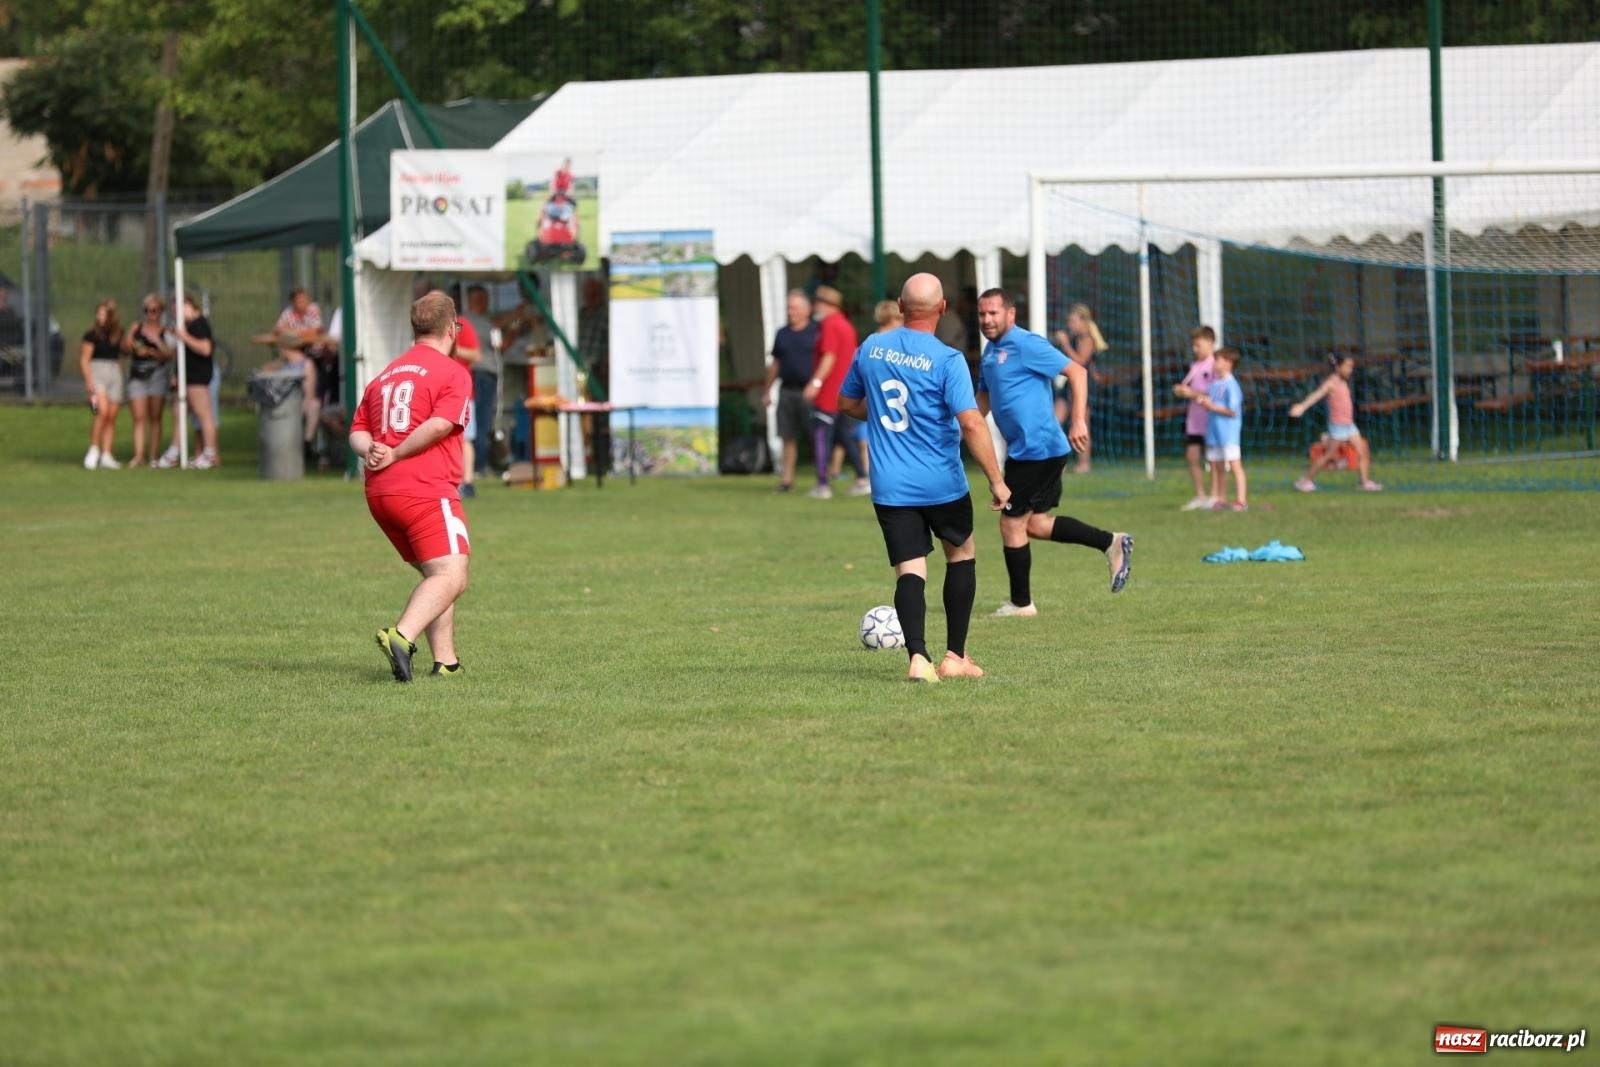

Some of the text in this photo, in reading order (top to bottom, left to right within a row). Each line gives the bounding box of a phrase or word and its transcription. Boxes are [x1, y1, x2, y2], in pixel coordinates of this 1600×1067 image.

[400, 193, 496, 215] PROSAT
[870, 346, 932, 371] LKS BOJANÓW
[381, 379, 415, 435] 18
[880, 379, 909, 433] 3
